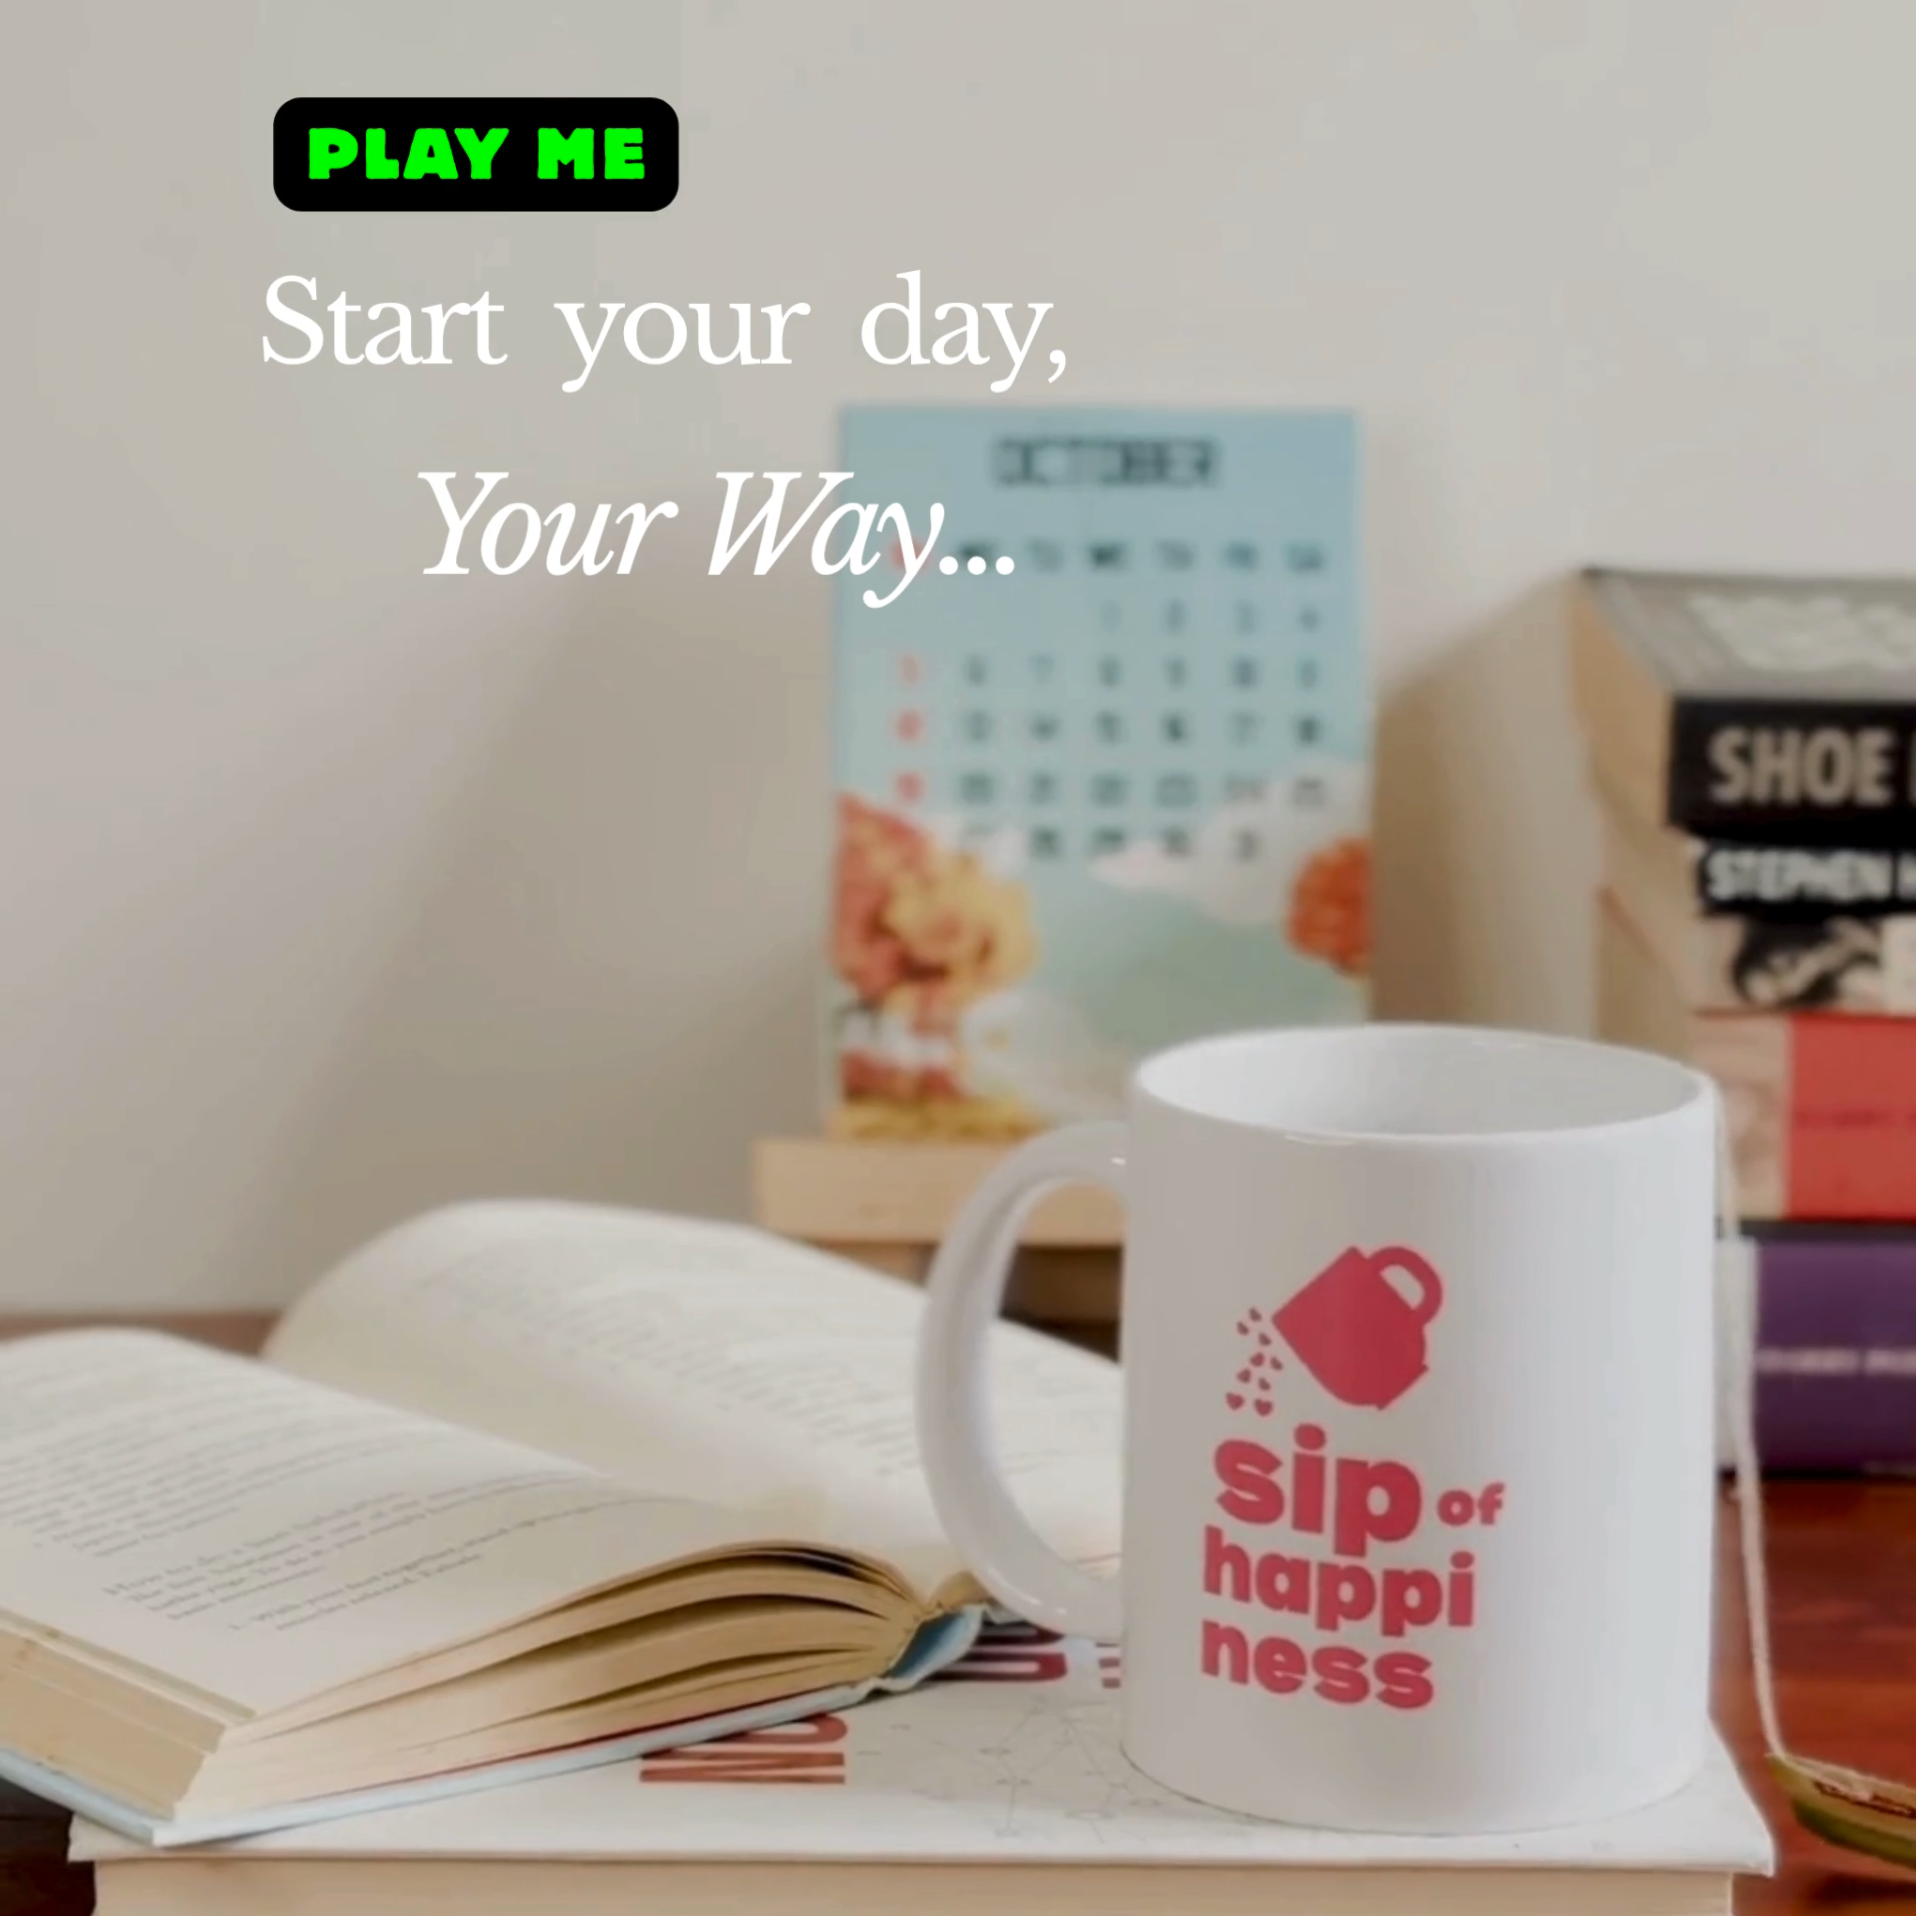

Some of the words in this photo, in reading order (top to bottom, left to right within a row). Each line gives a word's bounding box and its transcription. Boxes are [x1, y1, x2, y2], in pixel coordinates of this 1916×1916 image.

[1708, 724, 1896, 807] SHOE
[1706, 848, 1893, 902] STEPHEN
[1213, 1422, 1422, 1559] sip
[1436, 1482, 1506, 1527] of
[1203, 1524, 1476, 1639] happi
[1201, 1618, 1436, 1711] ness
